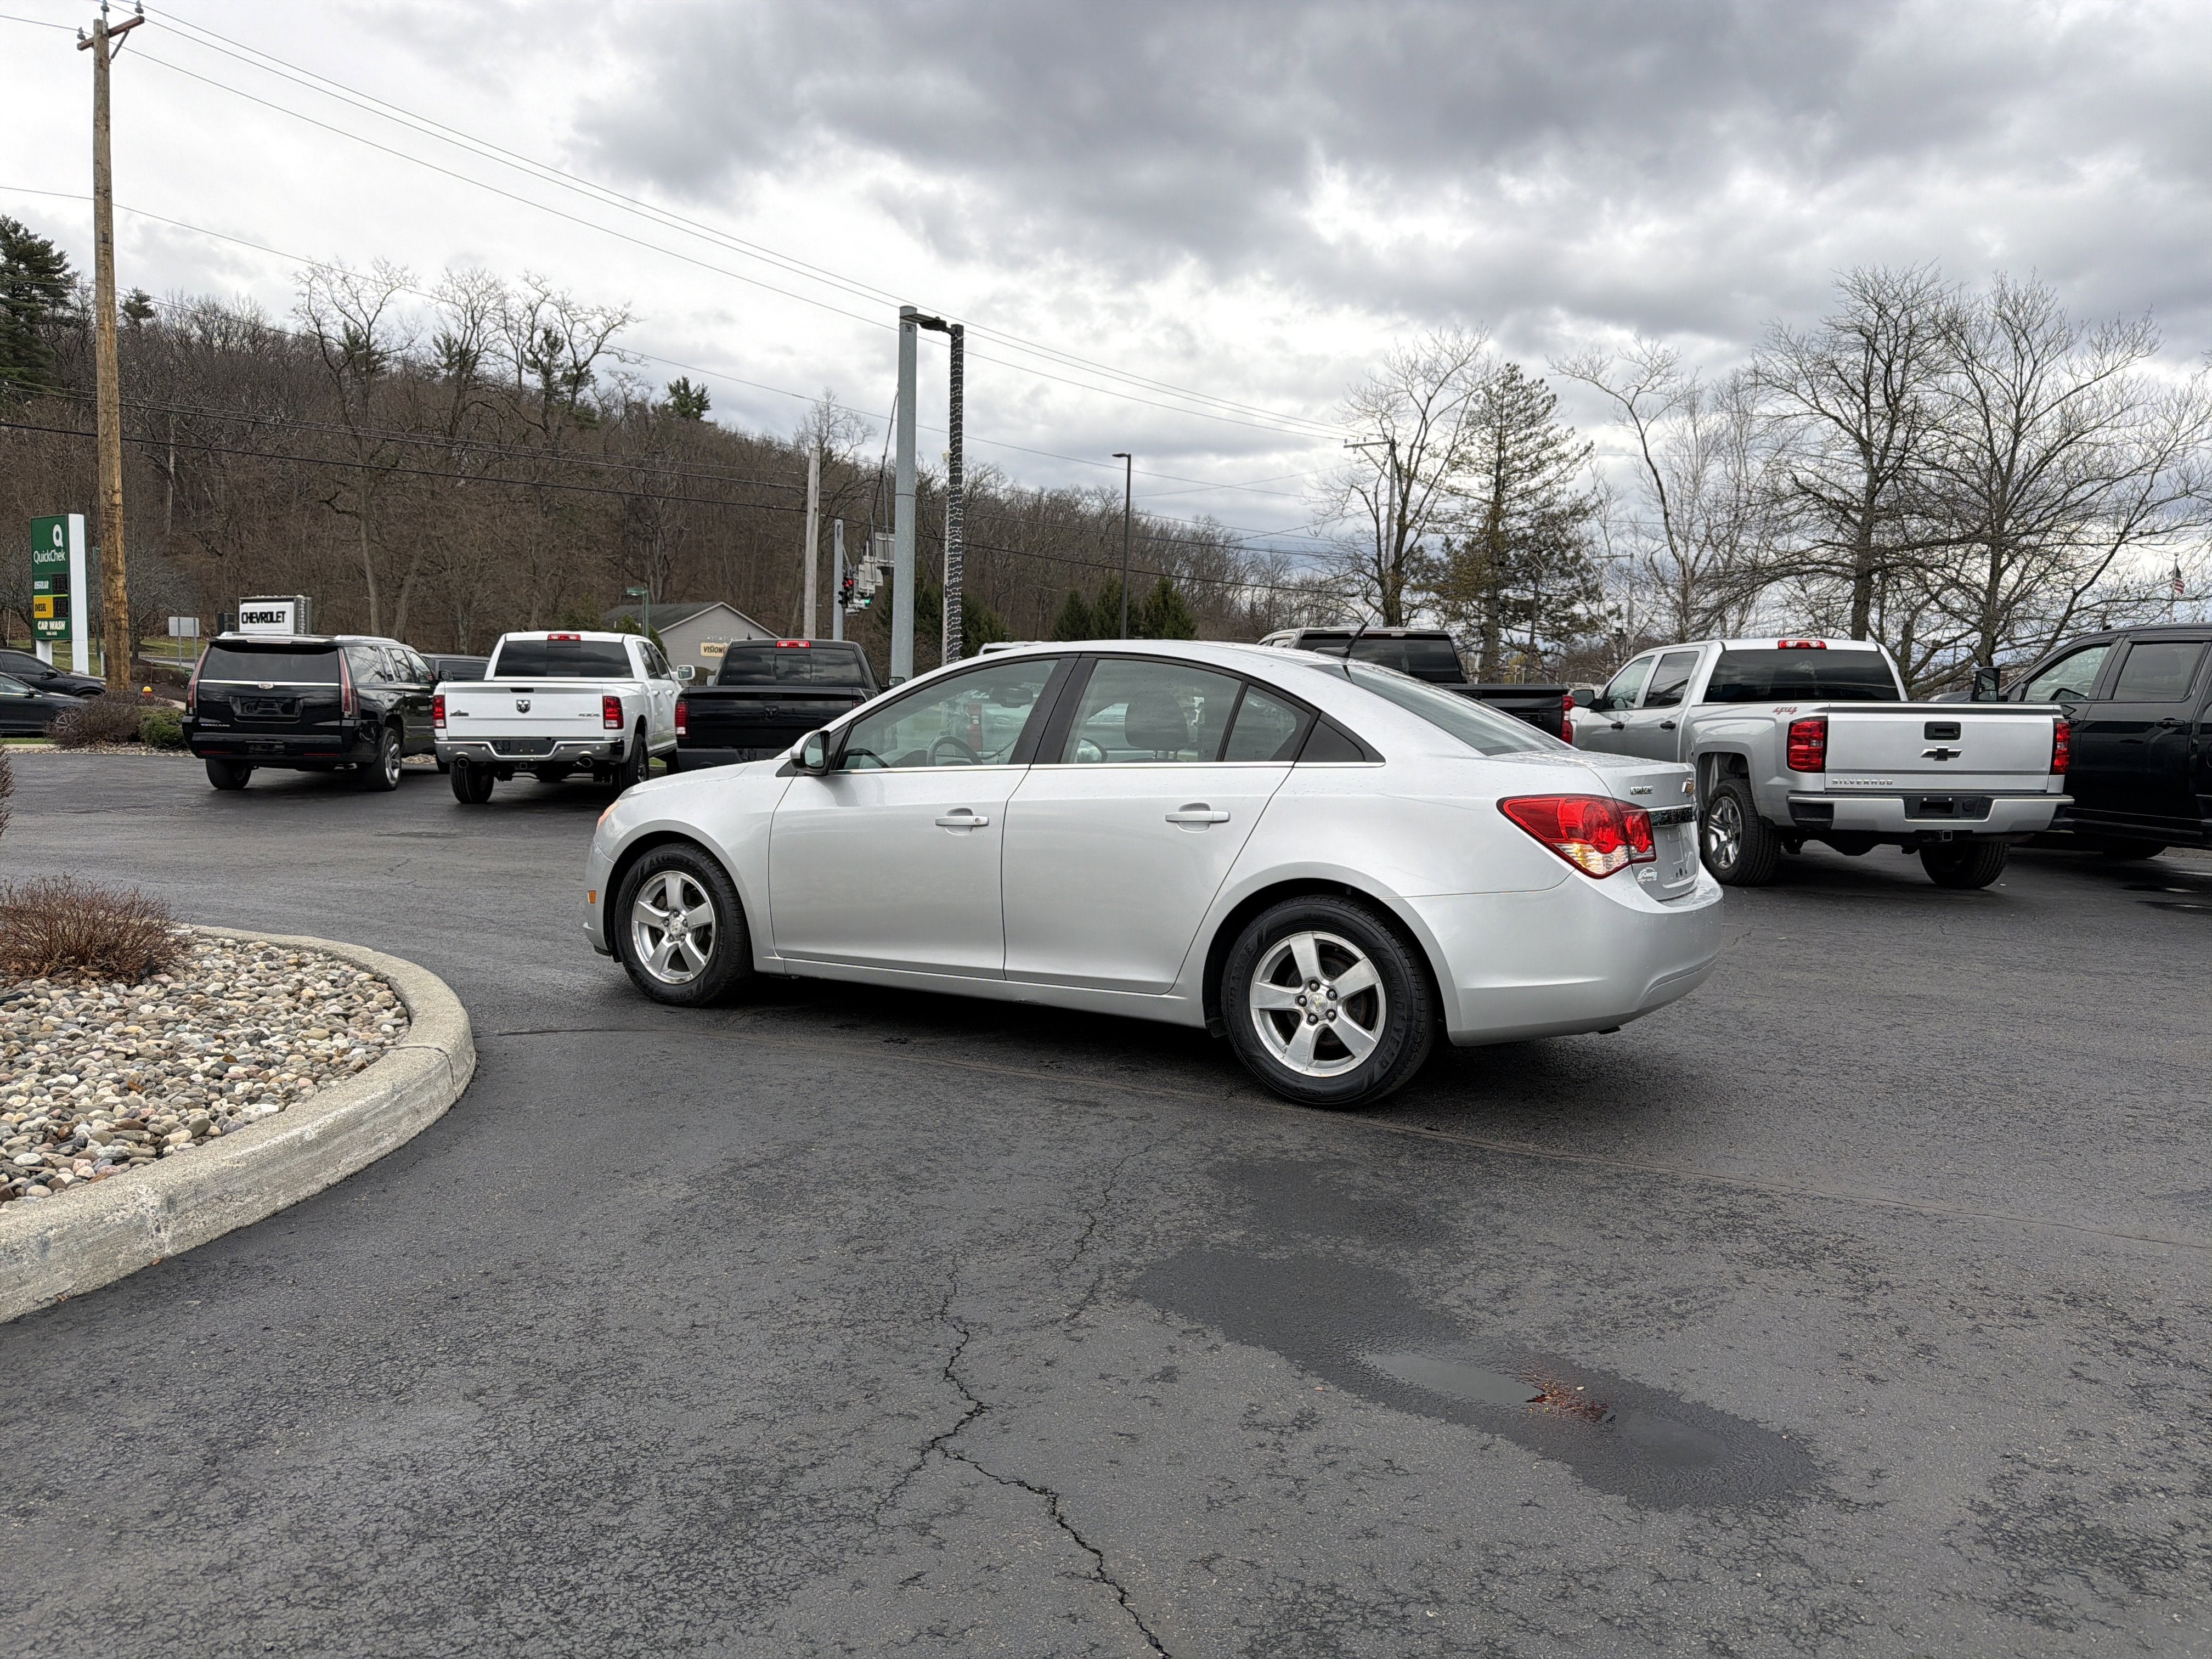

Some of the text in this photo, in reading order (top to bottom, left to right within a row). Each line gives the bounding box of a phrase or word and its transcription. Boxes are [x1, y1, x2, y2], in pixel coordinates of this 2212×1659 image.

[33, 548, 65, 565] QuickChek
[241, 611, 286, 624] CHEVROLET
[37, 620, 65, 630] CAR WASH
